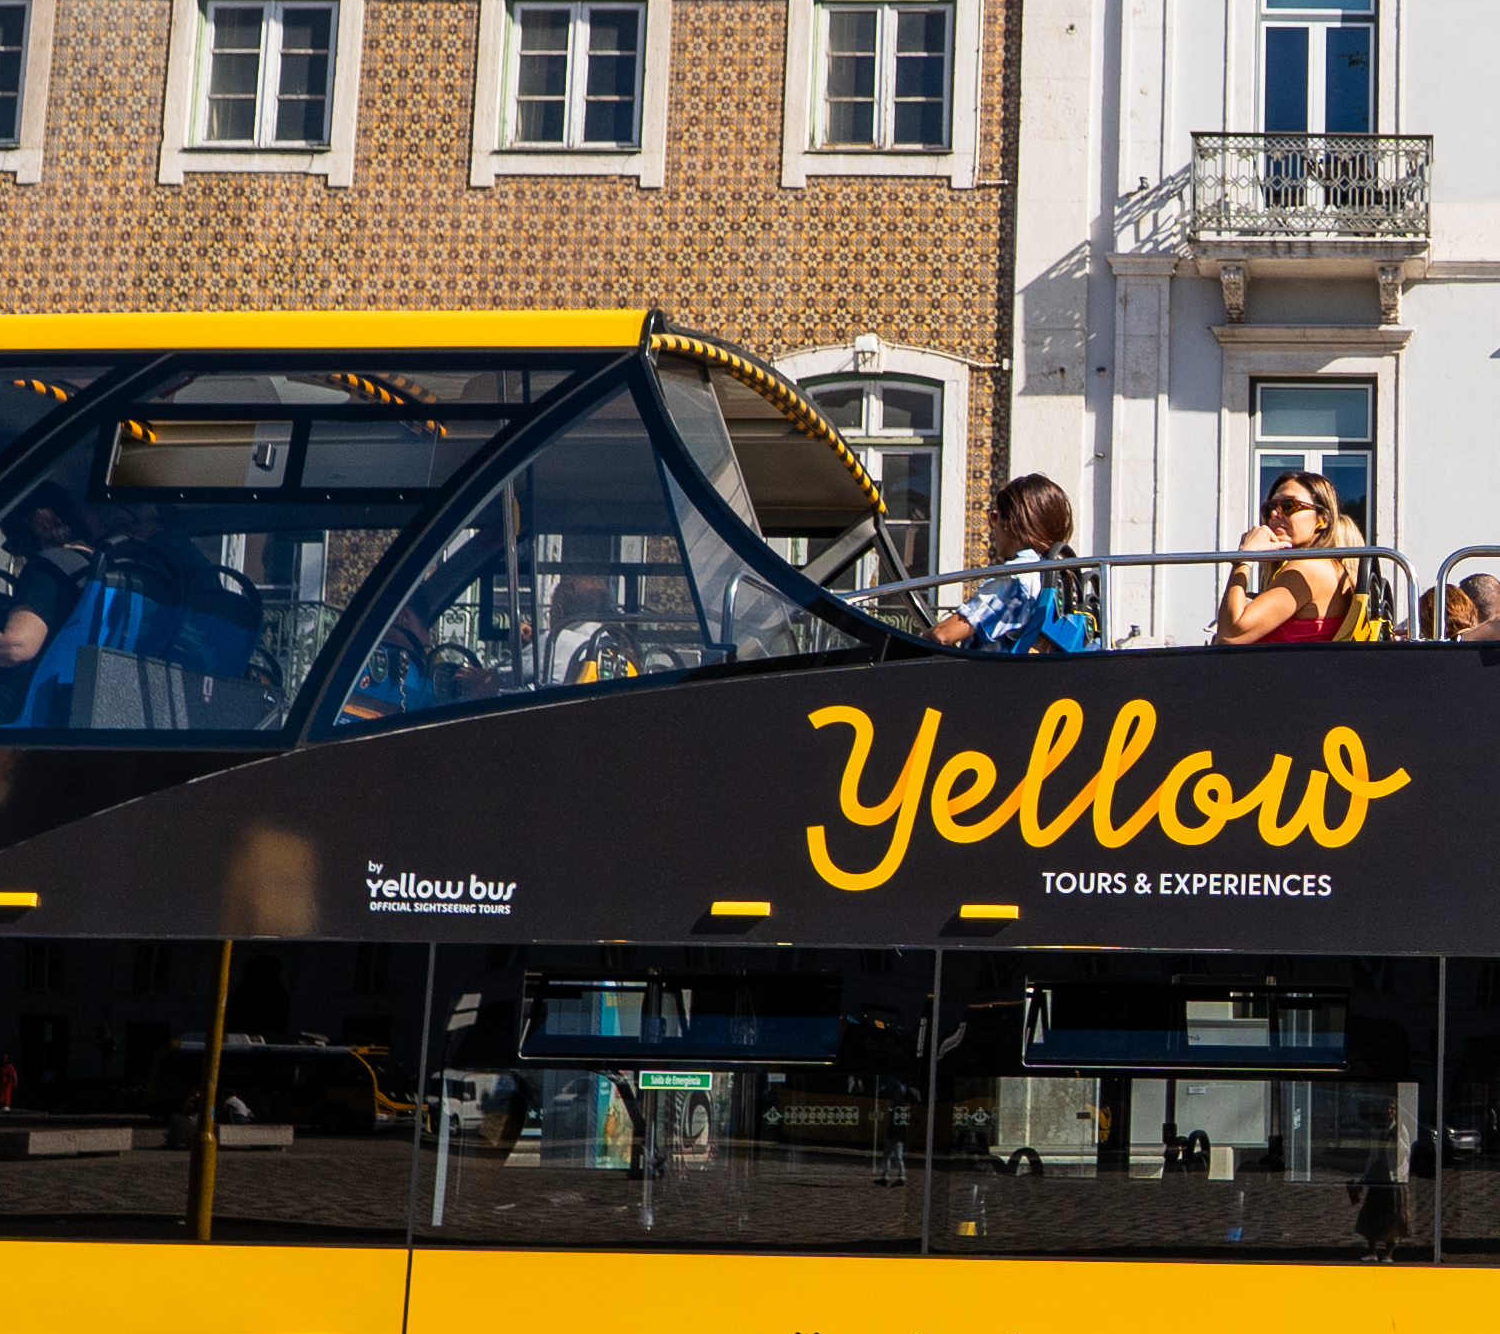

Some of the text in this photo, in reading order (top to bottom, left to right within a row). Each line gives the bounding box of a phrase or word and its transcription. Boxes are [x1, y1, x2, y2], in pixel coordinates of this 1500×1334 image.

[806, 698, 1412, 892] Yellow
[368, 860, 384, 875] by
[469, 874, 517, 901] bus
[1042, 872, 1332, 897] TOURS & EXPERIENCES
[369, 901, 511, 915] OFFICIAL SIGHTSEEING TOURS
